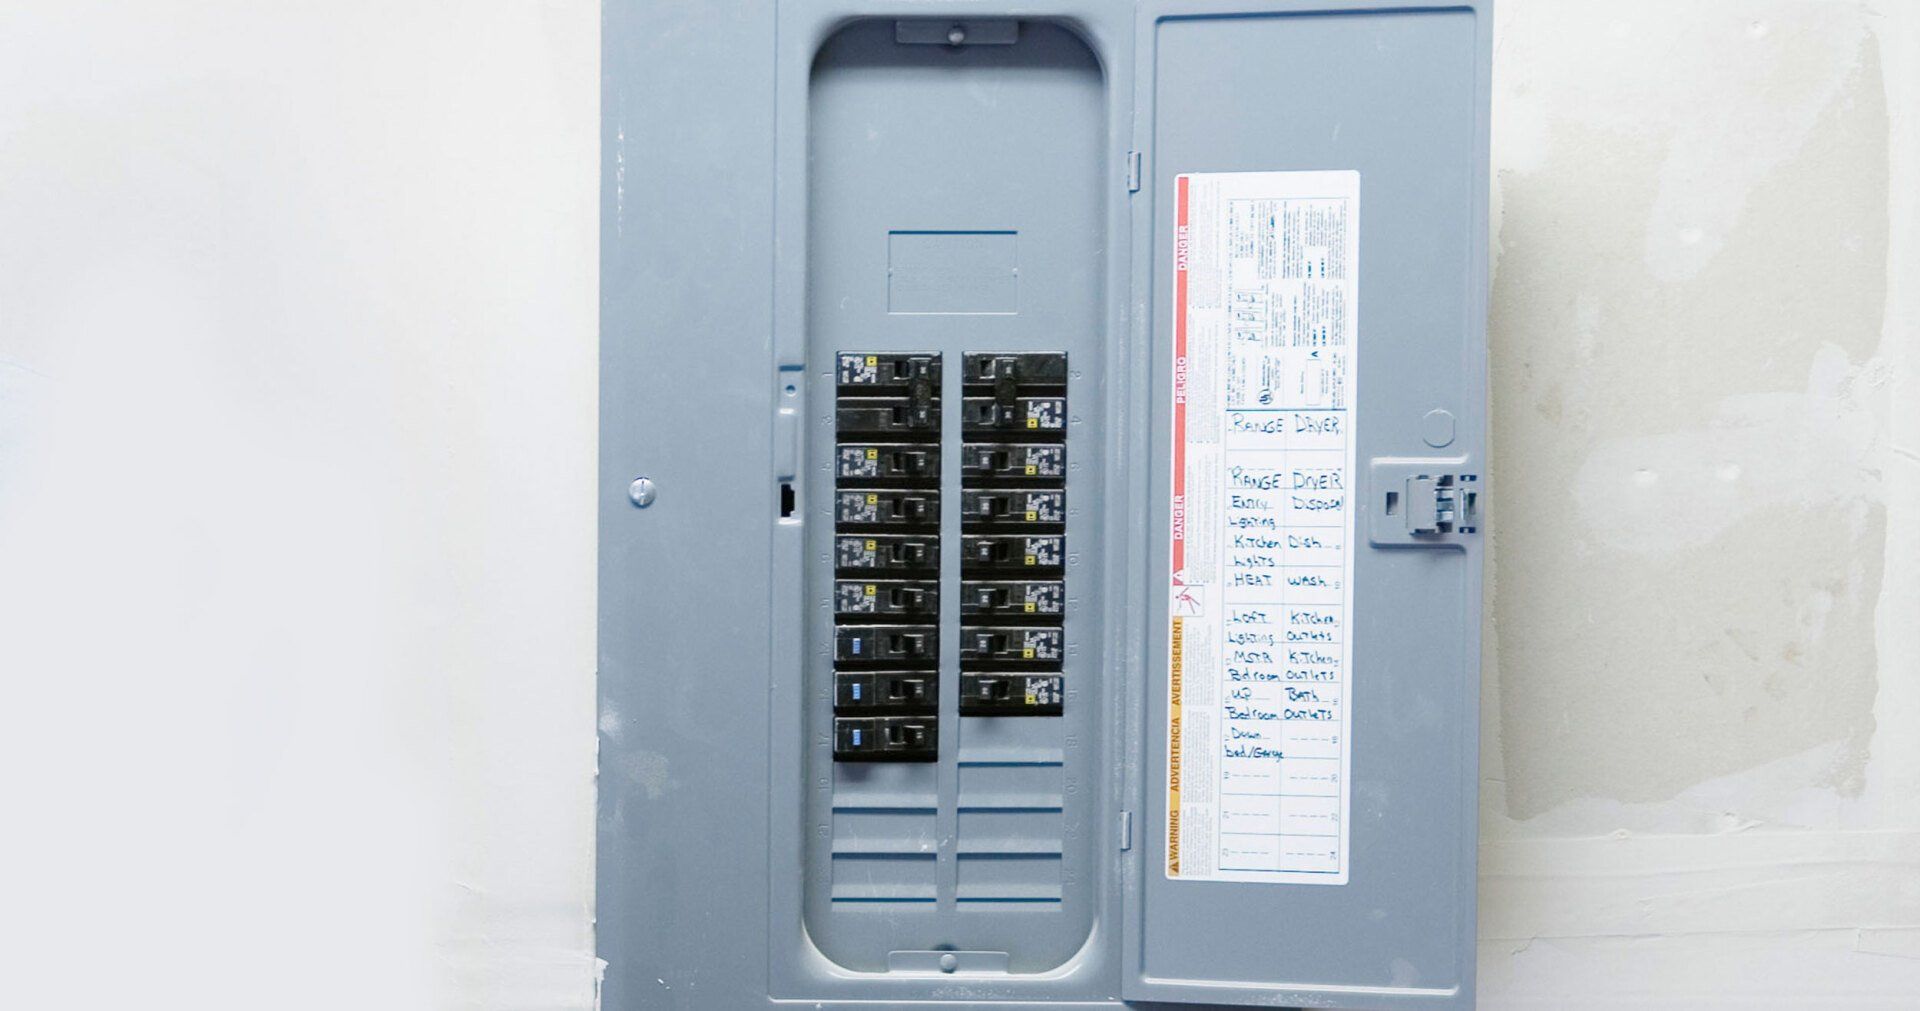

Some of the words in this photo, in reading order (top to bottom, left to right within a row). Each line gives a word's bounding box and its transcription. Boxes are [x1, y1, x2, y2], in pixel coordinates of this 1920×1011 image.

[1178, 226, 1188, 270] DANGER
[1176, 356, 1186, 404] PELIGRO
[1174, 495, 1184, 540] DANGER
[1234, 573, 1272, 586] HEAT
[1172, 620, 1182, 705] AVERTISSEMENT
[1170, 717, 1180, 791] ADVERTENCIA
[1169, 810, 1179, 861] WARNING
